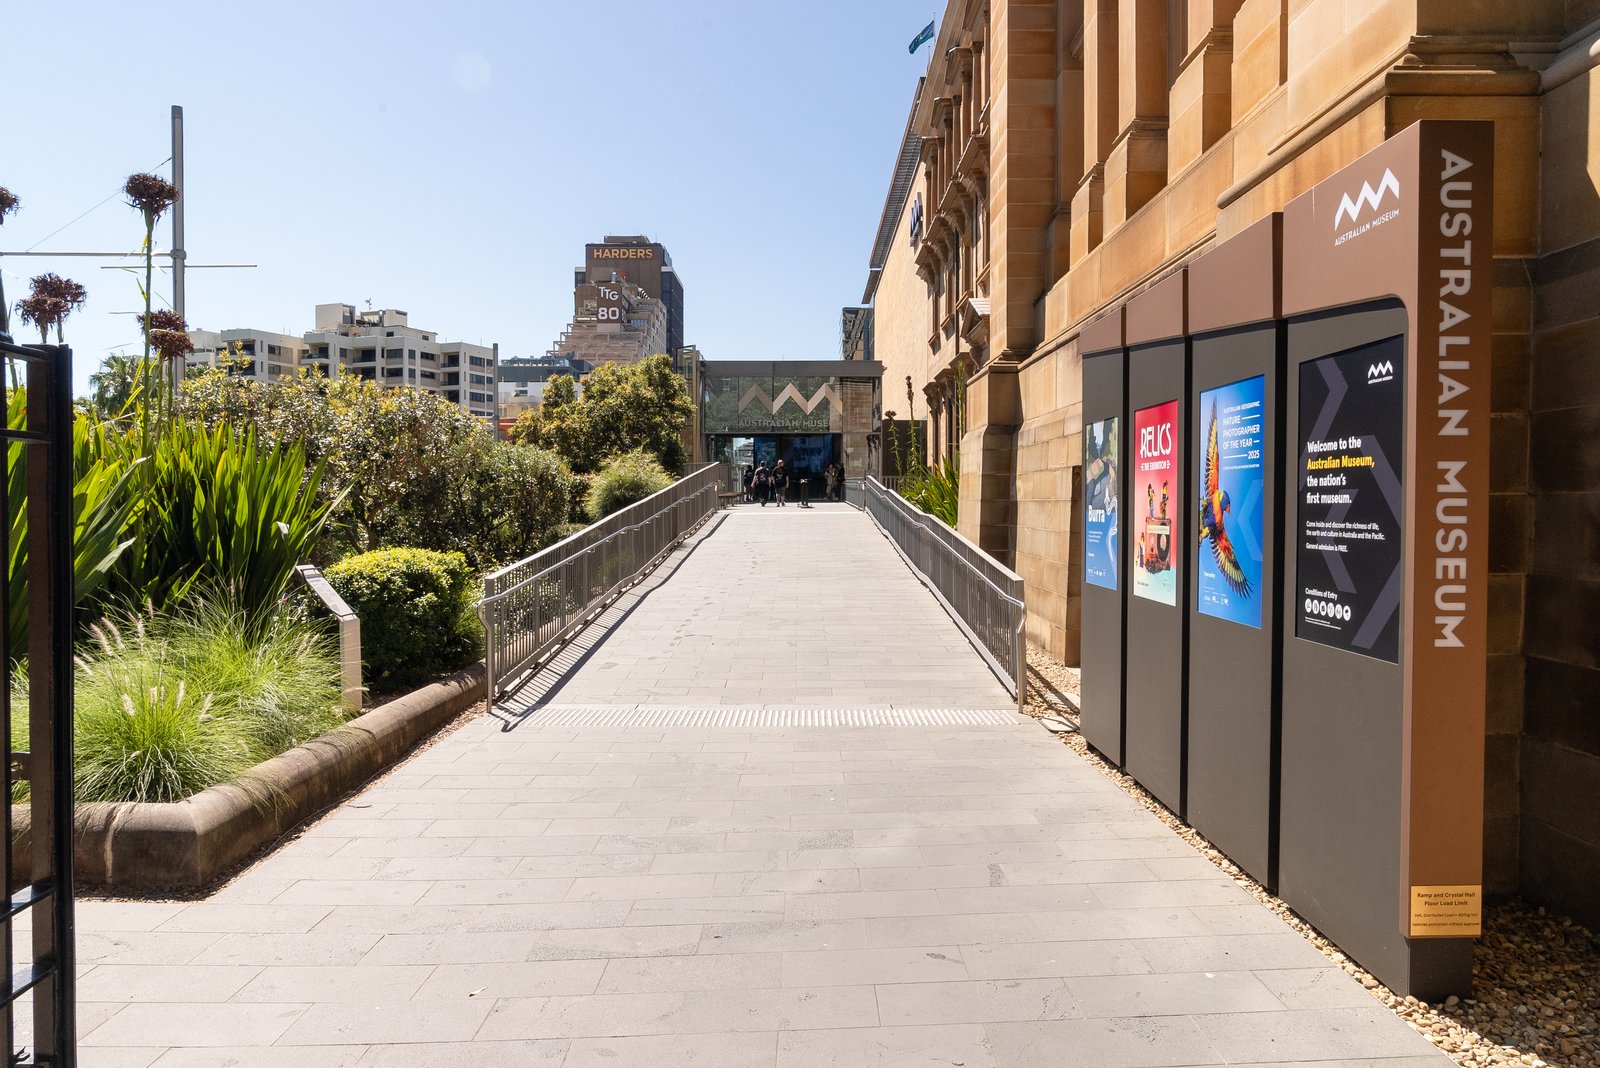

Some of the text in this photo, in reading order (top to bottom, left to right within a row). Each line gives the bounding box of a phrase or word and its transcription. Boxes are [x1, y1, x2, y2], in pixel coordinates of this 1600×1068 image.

[1335, 208, 1399, 247] AUSTRALIAN MUSEUM
[593, 248, 652, 259] HARDERS
[599, 286, 619, 301] TTG
[598, 307, 620, 320] 80
[1434, 149, 1473, 648] AUSTRALIAN MUSEUM
[738, 419, 799, 428] AUSTRALIAN
[1223, 415, 1240, 426] NATURE
[1223, 425, 1260, 438] PHOTOGRAPHER
[1140, 423, 1171, 458] RELICS
[1223, 438, 1252, 450] OF THE YEAR
[1307, 436, 1361, 453] Welcome to the
[1248, 450, 1260, 460] 2025
[1307, 455, 1375, 470] Australian Museum,
[1307, 473, 1346, 487] the nation's
[1307, 492, 1352, 504] first museum.
[1088, 505, 1105, 523] Burra
[1306, 542, 1318, 550] General
[1305, 588, 1323, 597] Conditions
[1328, 591, 1338, 601] Entry
